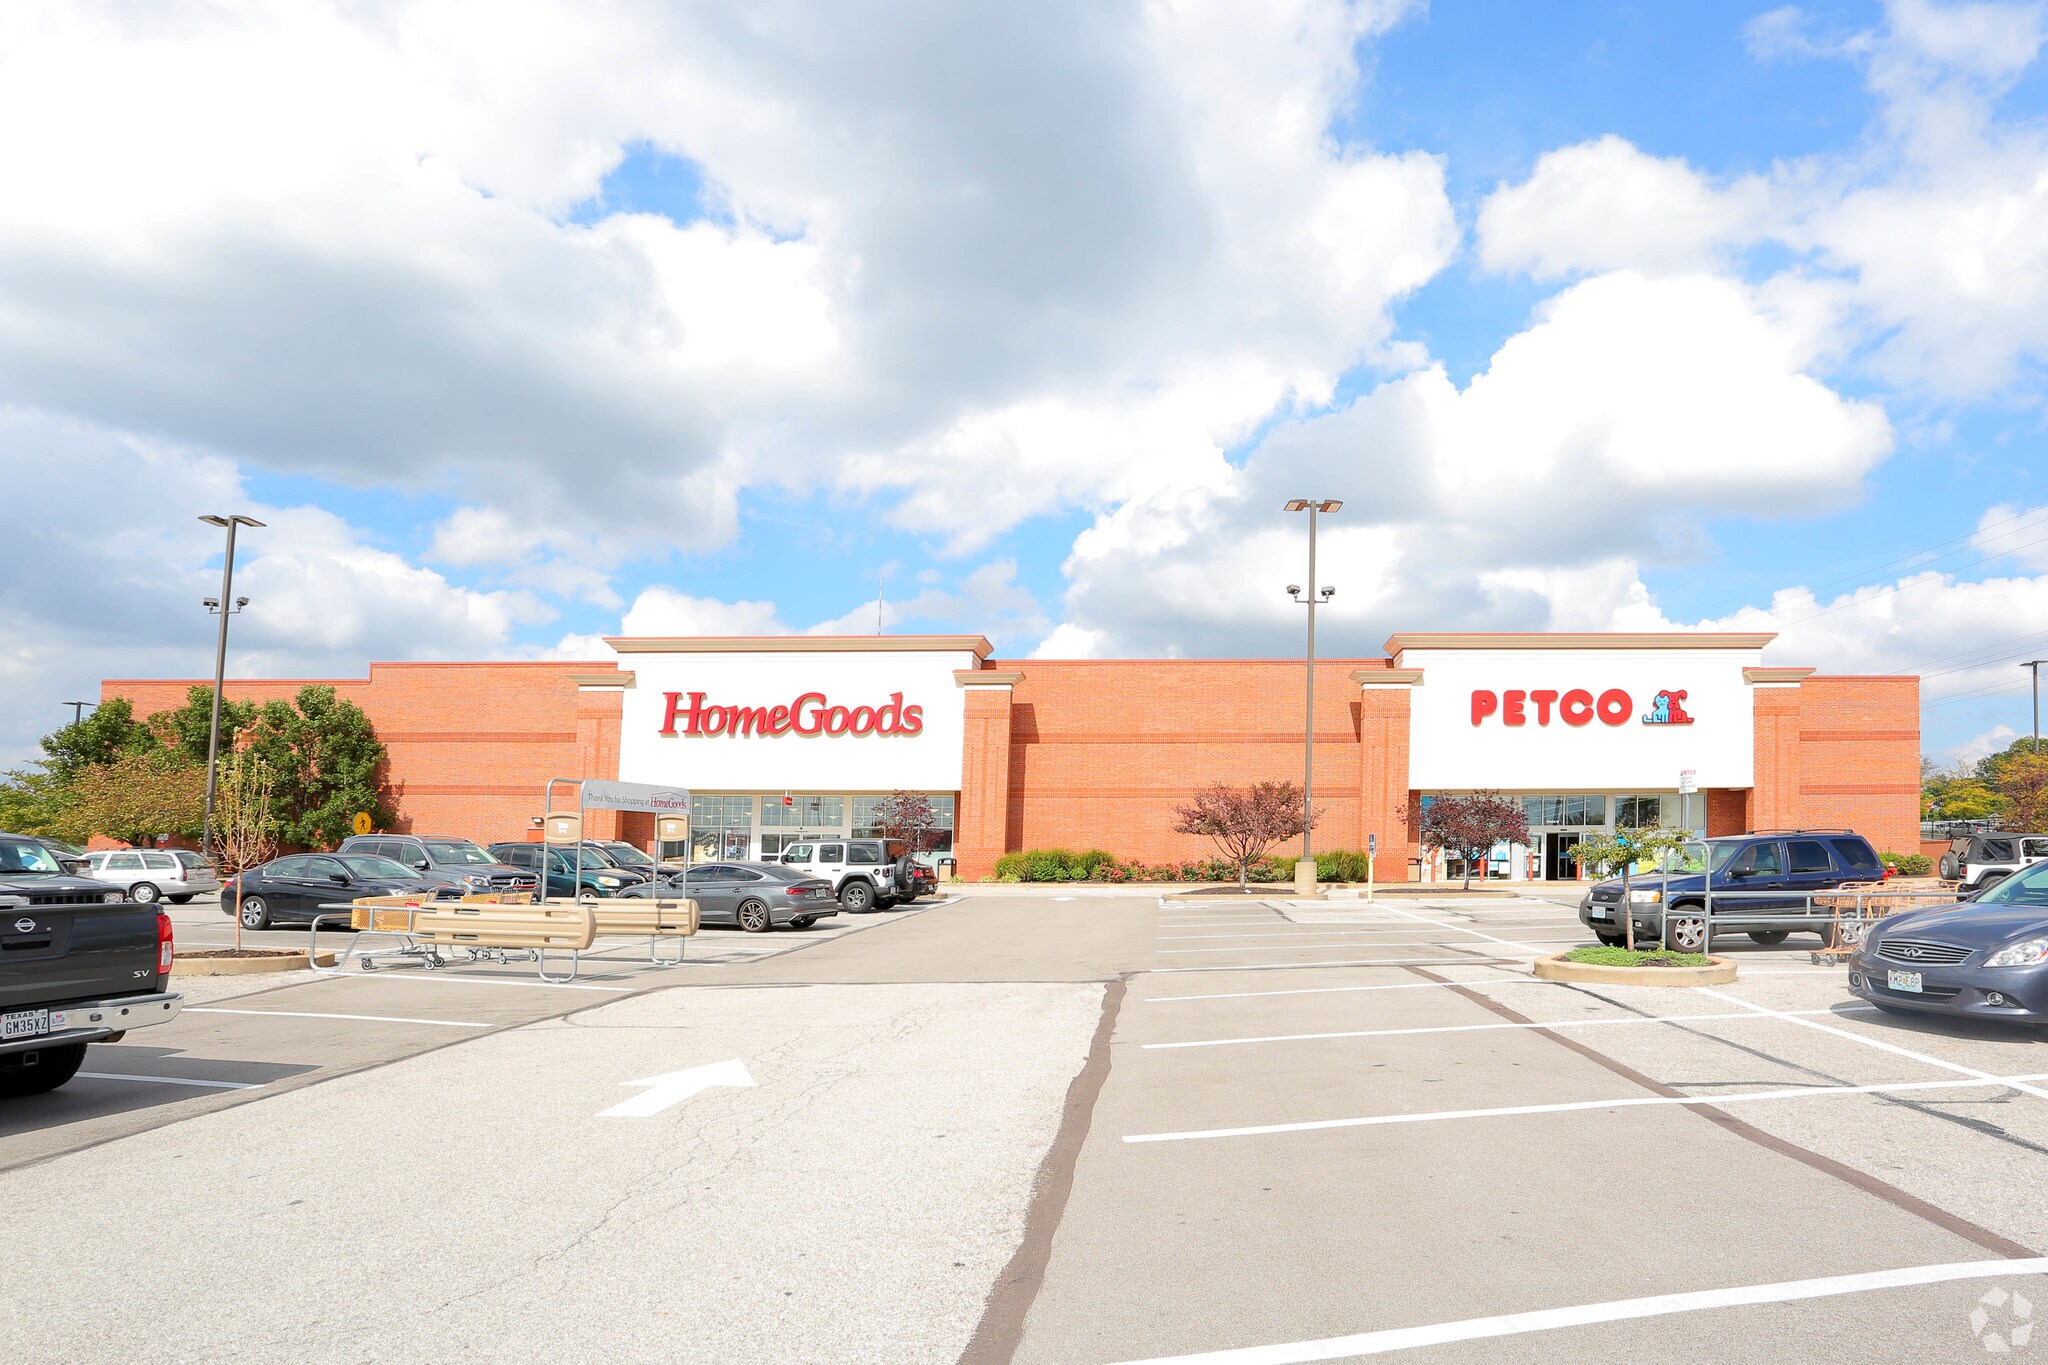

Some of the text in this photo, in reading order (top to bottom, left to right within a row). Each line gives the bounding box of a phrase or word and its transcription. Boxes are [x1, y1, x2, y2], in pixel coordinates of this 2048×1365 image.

[658, 691, 923, 737] HomeGoods
[1471, 688, 1634, 726] PETCO
[588, 793, 604, 803] Thank
[604, 795, 614, 803] You
[622, 796, 645, 806] Shopping
[650, 797, 687, 809] HomeGoods
[133, 969, 150, 978] SV
[5, 1012, 34, 1020] TEXAS
